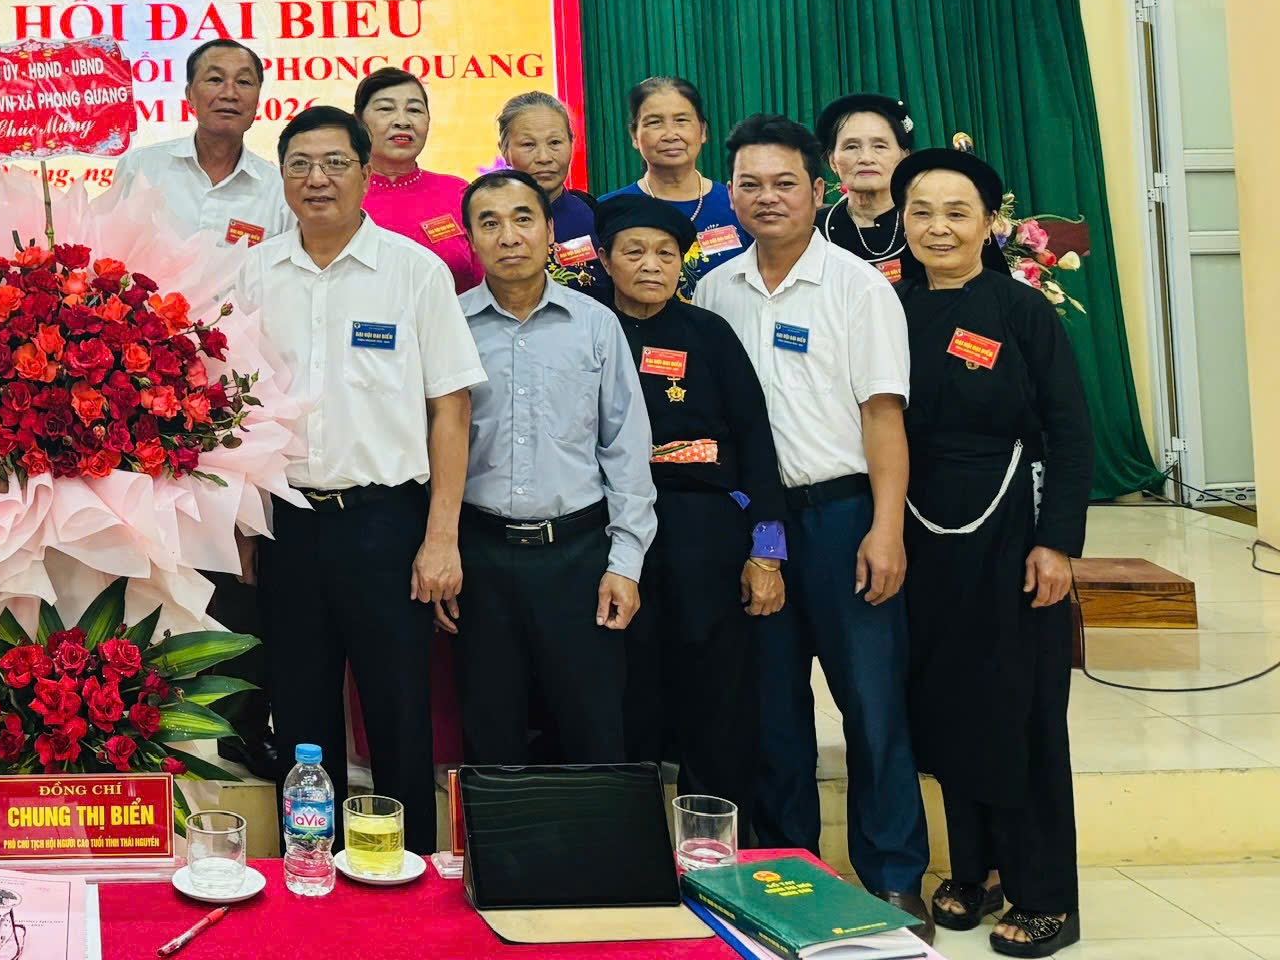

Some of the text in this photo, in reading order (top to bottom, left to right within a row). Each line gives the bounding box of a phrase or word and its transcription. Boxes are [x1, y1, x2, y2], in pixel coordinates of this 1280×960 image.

[28, 60, 62, 80] HĐND
[71, 57, 104, 77] UBND
[402, 53, 544, 86] QUANG
[37, 90, 81, 110] PHONG
[83, 86, 128, 106] QUANG
[39, 780, 122, 796] ĐỒNG CHÍ
[7, 797, 154, 830] CHUNG THỊ BIỂN
[76, 838, 90, 848] CAO
